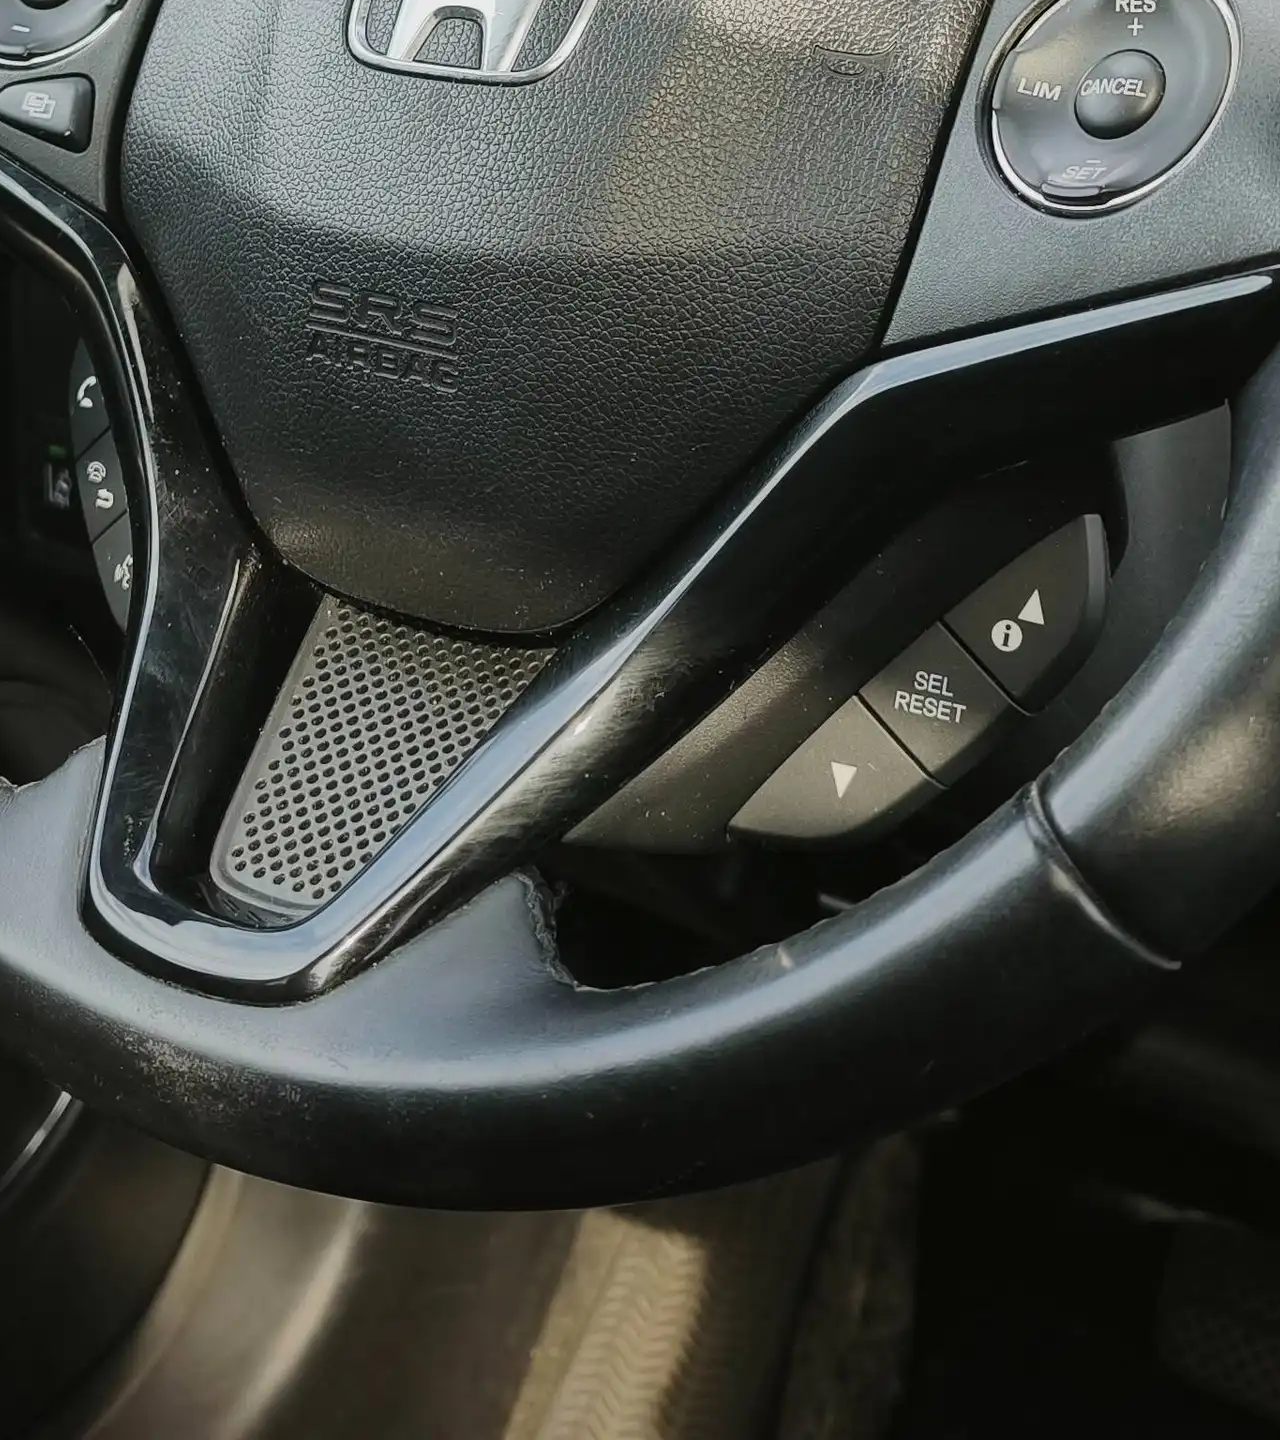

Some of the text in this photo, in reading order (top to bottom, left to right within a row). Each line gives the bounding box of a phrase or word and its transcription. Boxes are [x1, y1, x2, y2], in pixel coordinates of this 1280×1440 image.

[1017, 77, 1061, 101] LIM
[1079, 78, 1148, 99] CANCEL
[1061, 164, 1107, 181] SET
[309, 280, 459, 347] SRS
[305, 333, 459, 393] AIRBAG
[913, 670, 954, 698] SEL
[893, 690, 967, 724] RESET
